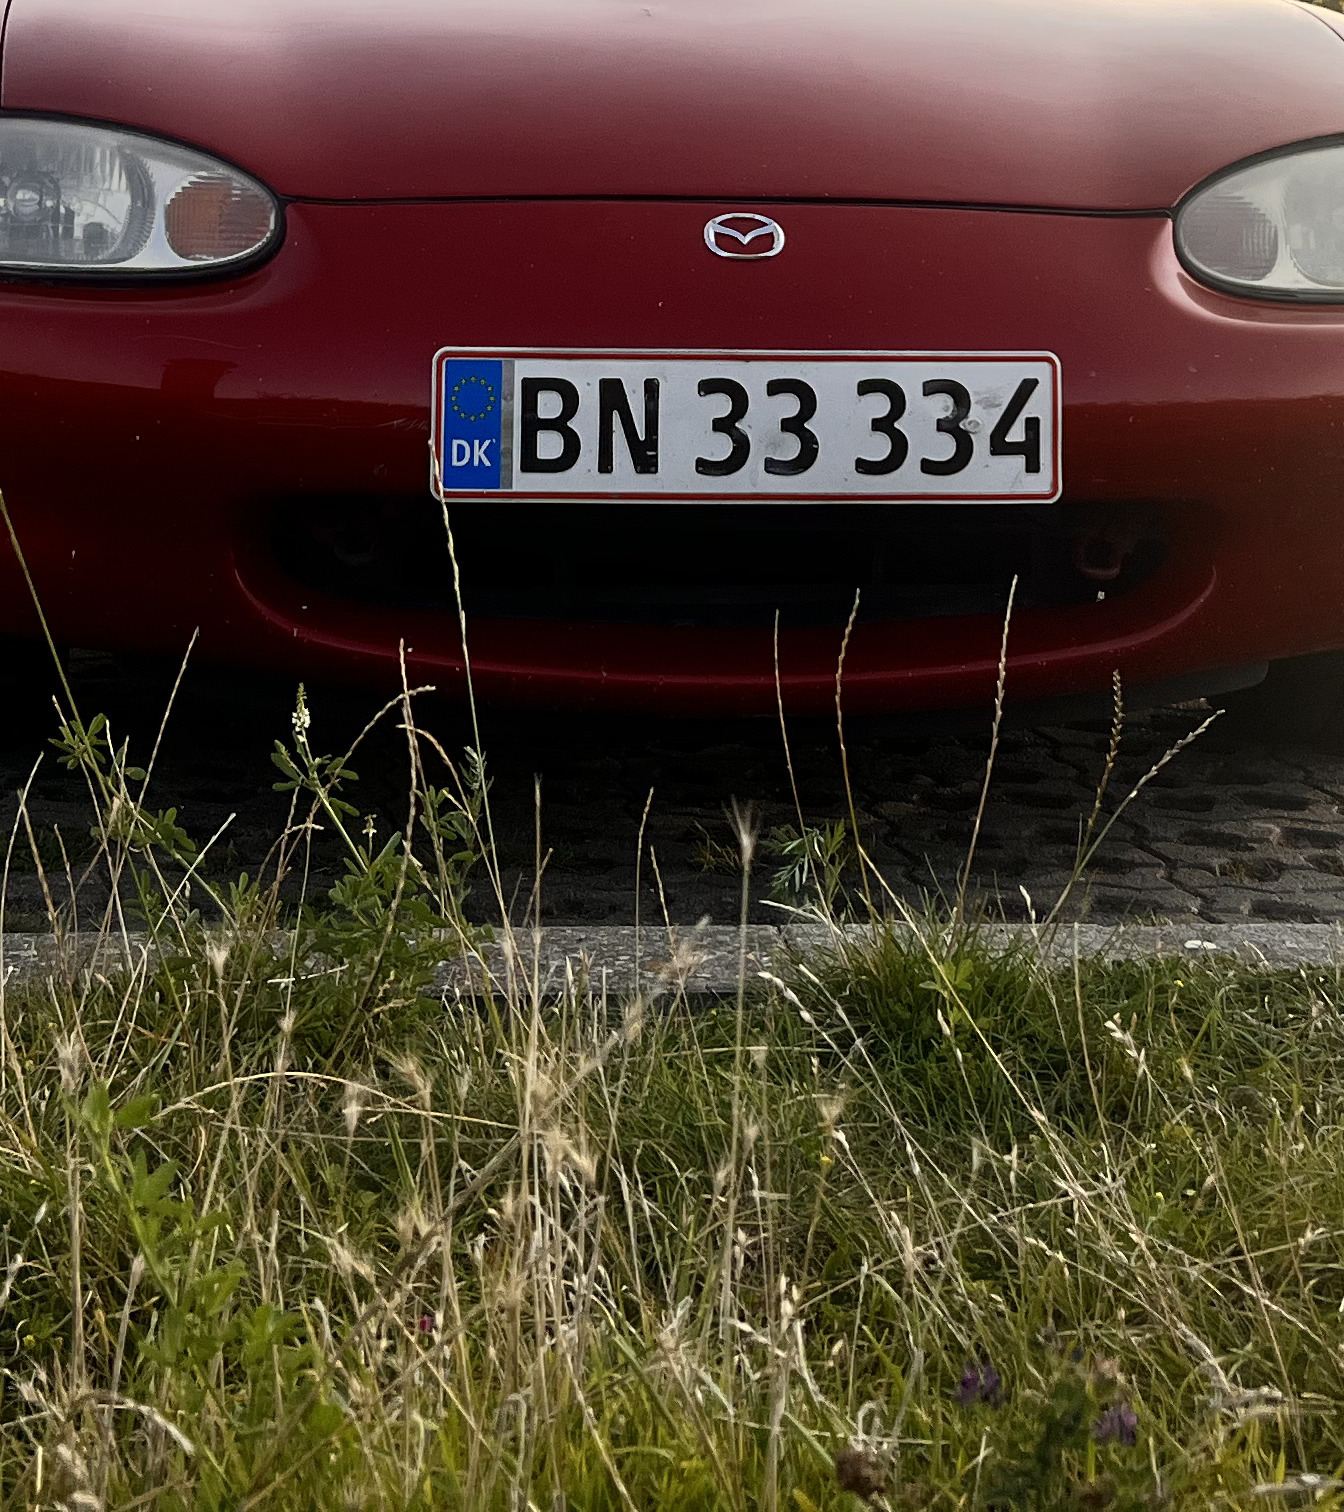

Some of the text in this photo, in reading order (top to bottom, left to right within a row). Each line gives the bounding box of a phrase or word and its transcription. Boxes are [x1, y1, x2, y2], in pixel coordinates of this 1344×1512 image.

[451, 438, 492, 468] DK
[519, 376, 1041, 476] BN 33 334
